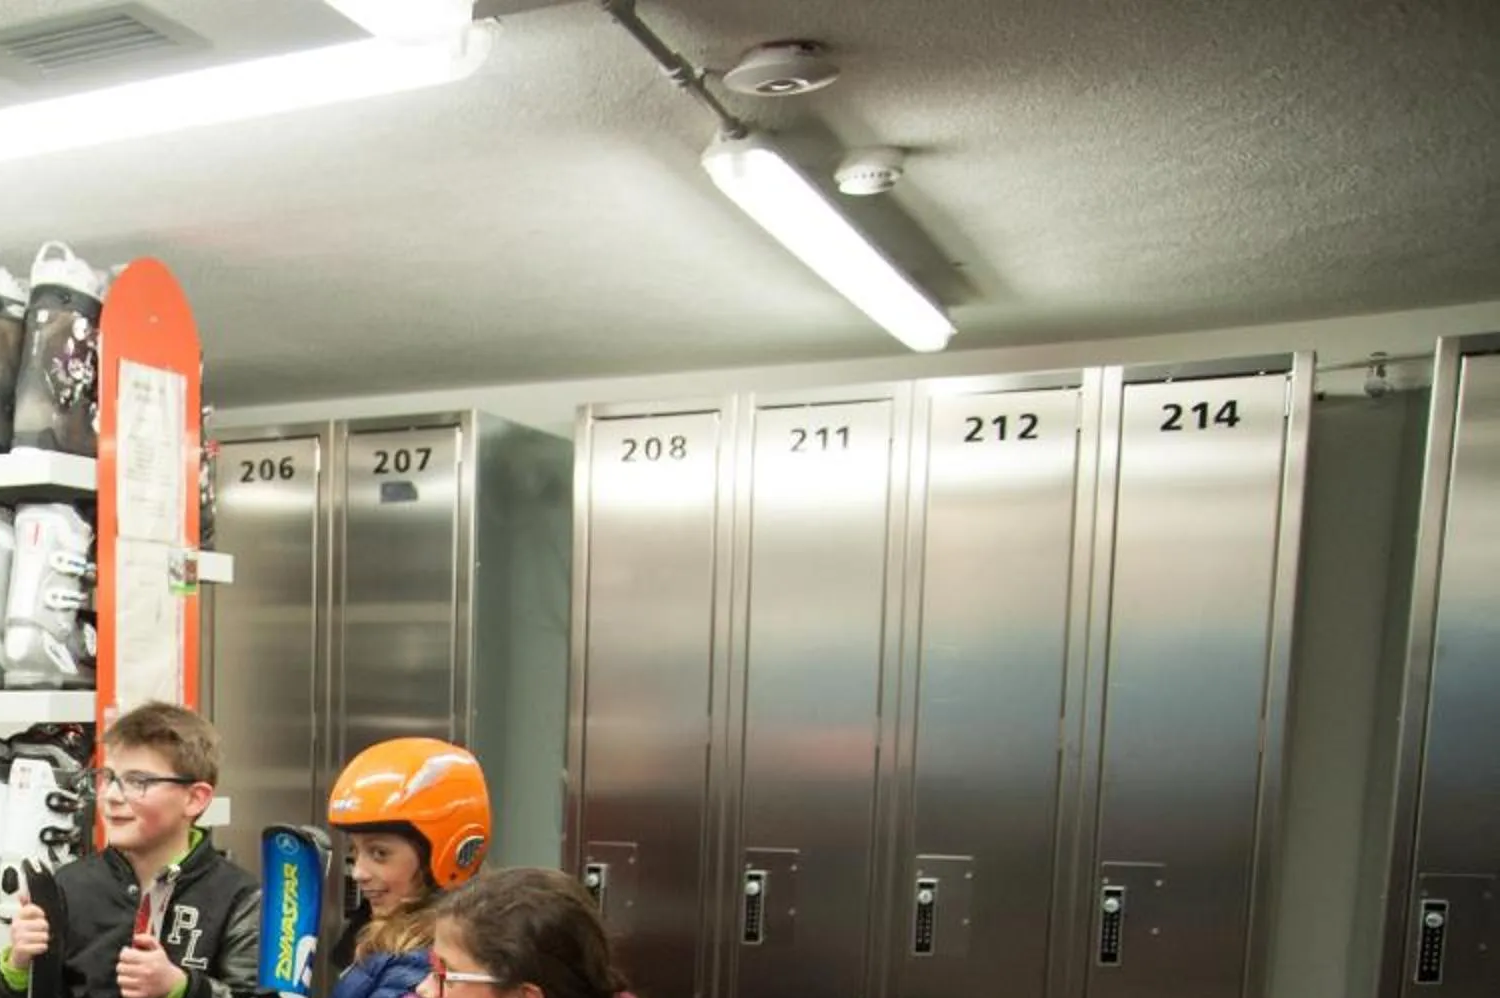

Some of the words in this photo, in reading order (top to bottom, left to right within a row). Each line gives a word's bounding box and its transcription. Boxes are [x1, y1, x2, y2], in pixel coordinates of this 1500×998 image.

[964, 413, 1038, 442] 212
[1160, 400, 1240, 431] 214
[621, 435, 687, 462] 208
[790, 426, 850, 452] 211
[240, 456, 295, 483] 206
[373, 447, 432, 474] 207
[275, 863, 298, 981] DYNASTAR
